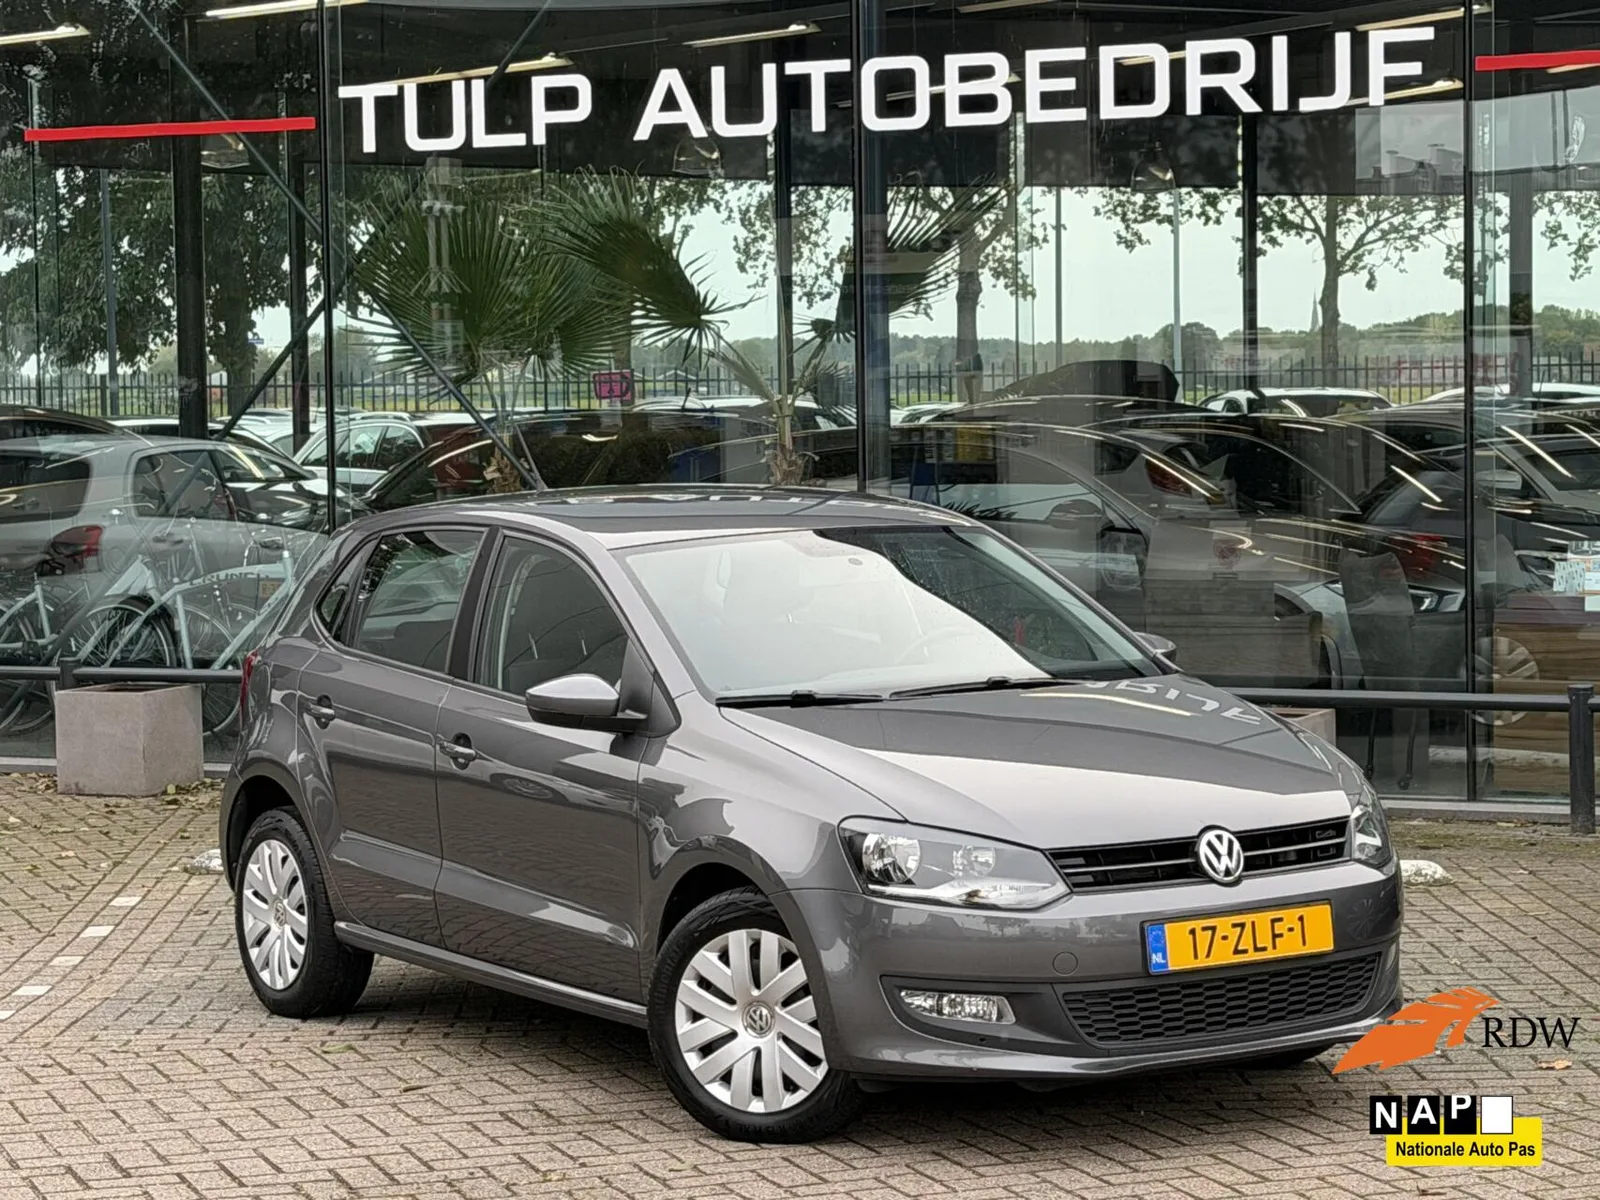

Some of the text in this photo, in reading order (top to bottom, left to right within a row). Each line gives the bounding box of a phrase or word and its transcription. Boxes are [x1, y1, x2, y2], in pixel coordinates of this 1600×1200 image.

[338, 27, 1436, 153] TULP AUTOBEDRIJF
[1152, 952, 1166, 964] NL
[1188, 914, 1307, 961] 17-ZLF-1
